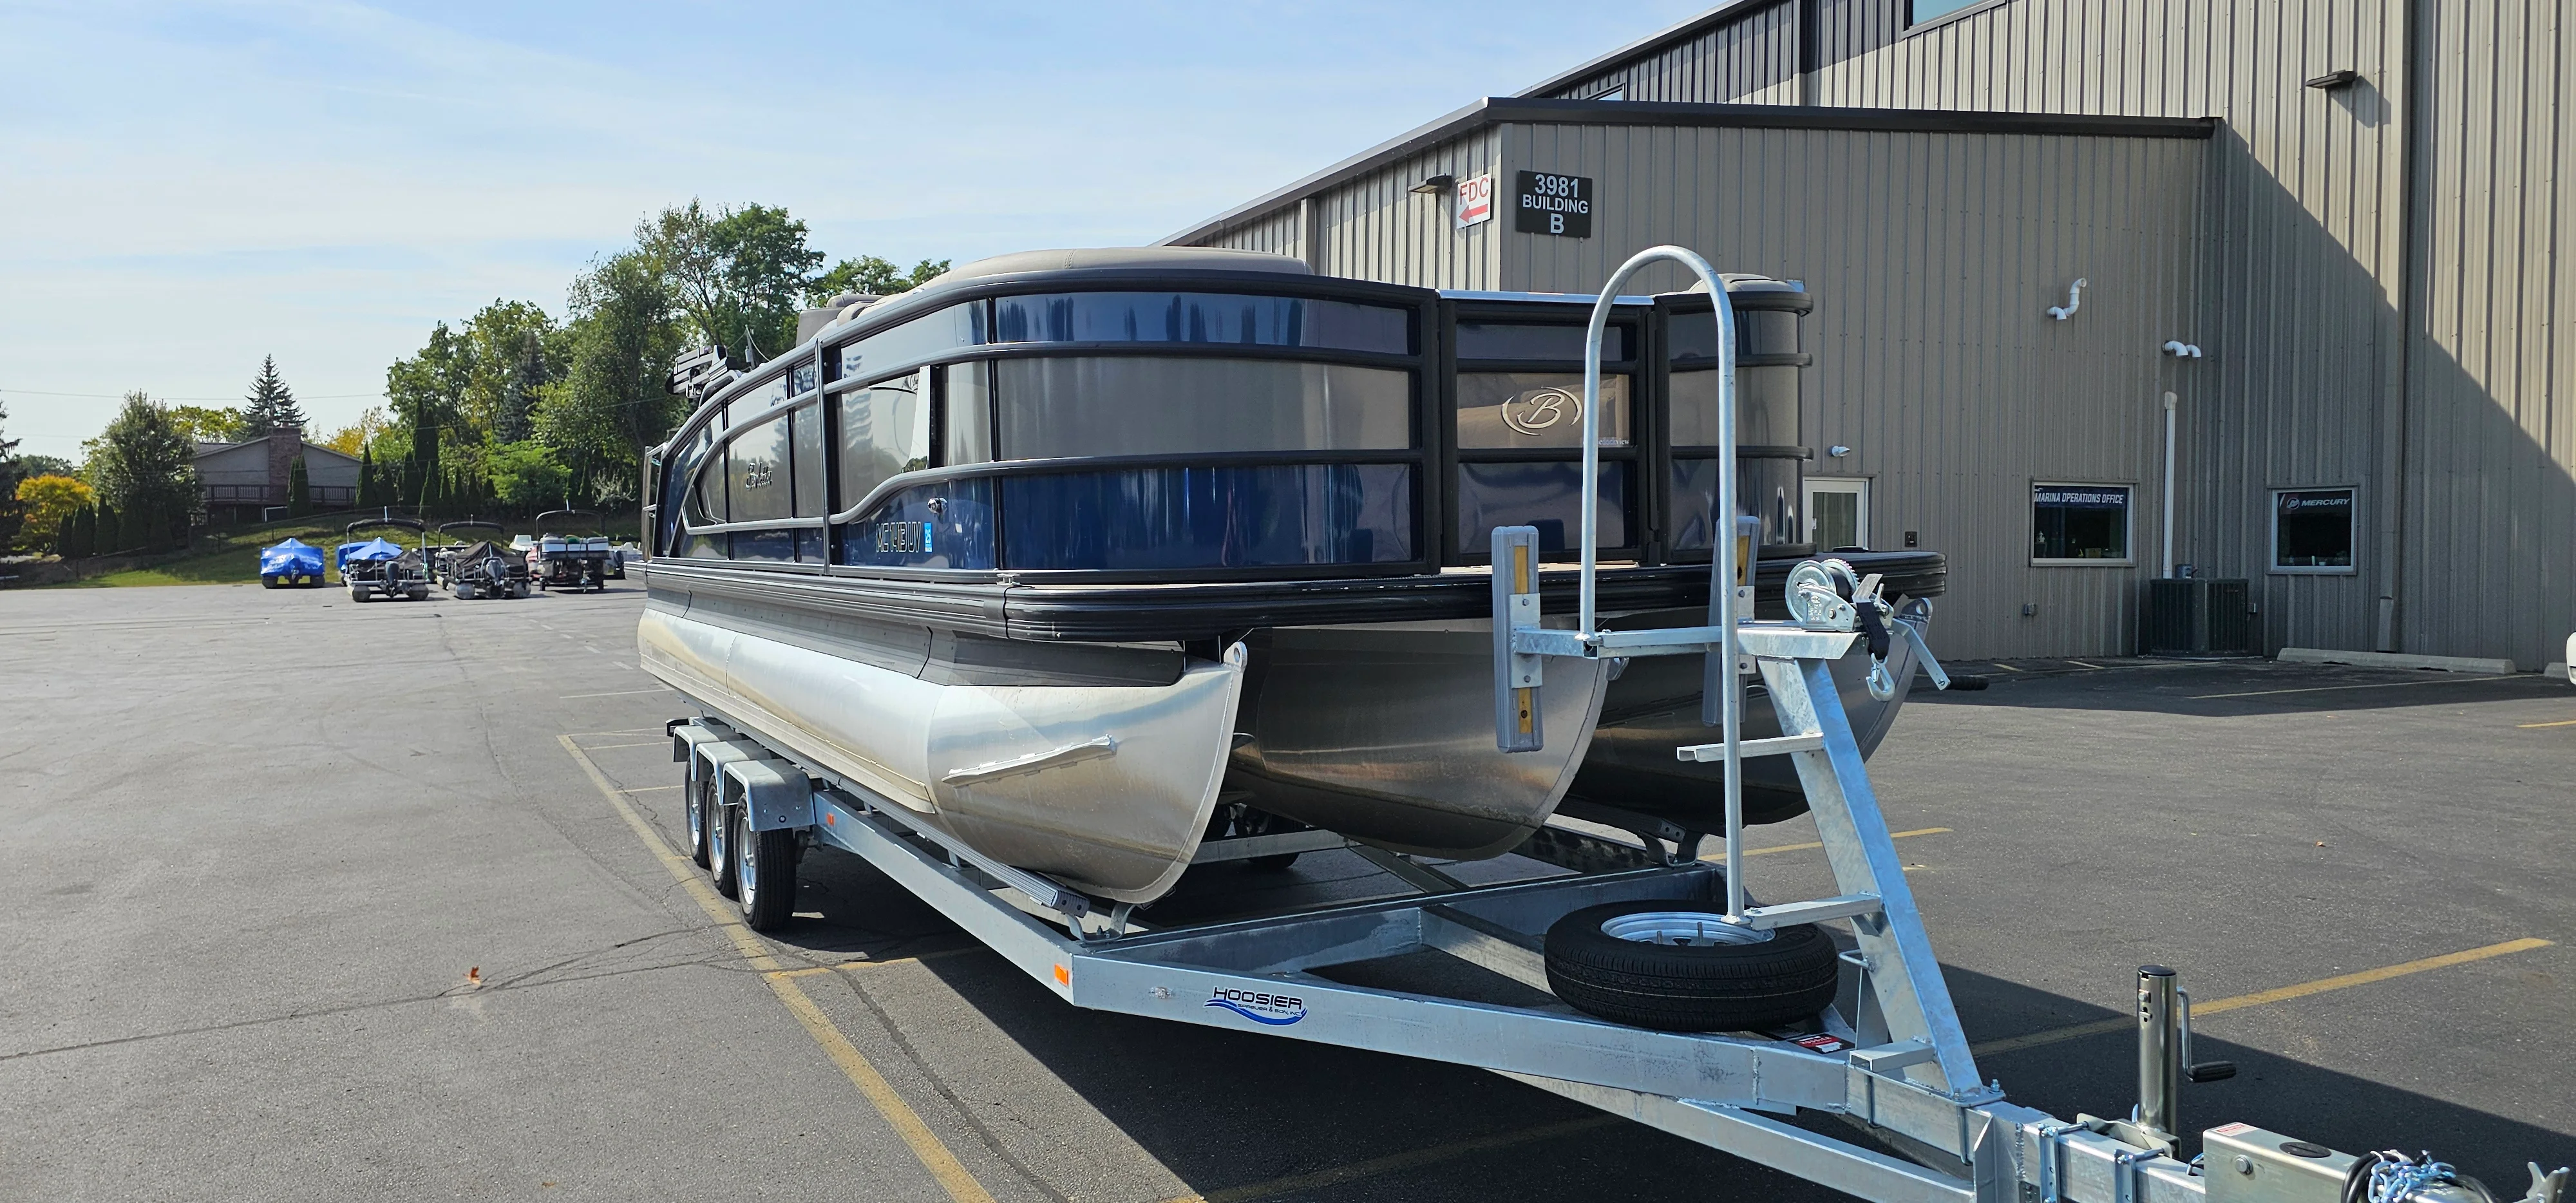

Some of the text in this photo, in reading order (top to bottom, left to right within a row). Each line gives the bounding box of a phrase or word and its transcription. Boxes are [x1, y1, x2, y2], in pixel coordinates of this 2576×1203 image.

[1459, 177, 1489, 205] FDC
[1535, 174, 1578, 198] 3981
[1522, 194, 1588, 214] BUILDING
[1550, 213, 1564, 234] B
[2034, 493, 2124, 504] MARINA OPERATIONS OFFICE
[2301, 498, 2351, 506] MERCURY
[1213, 987, 1302, 1010] HOOSIER
